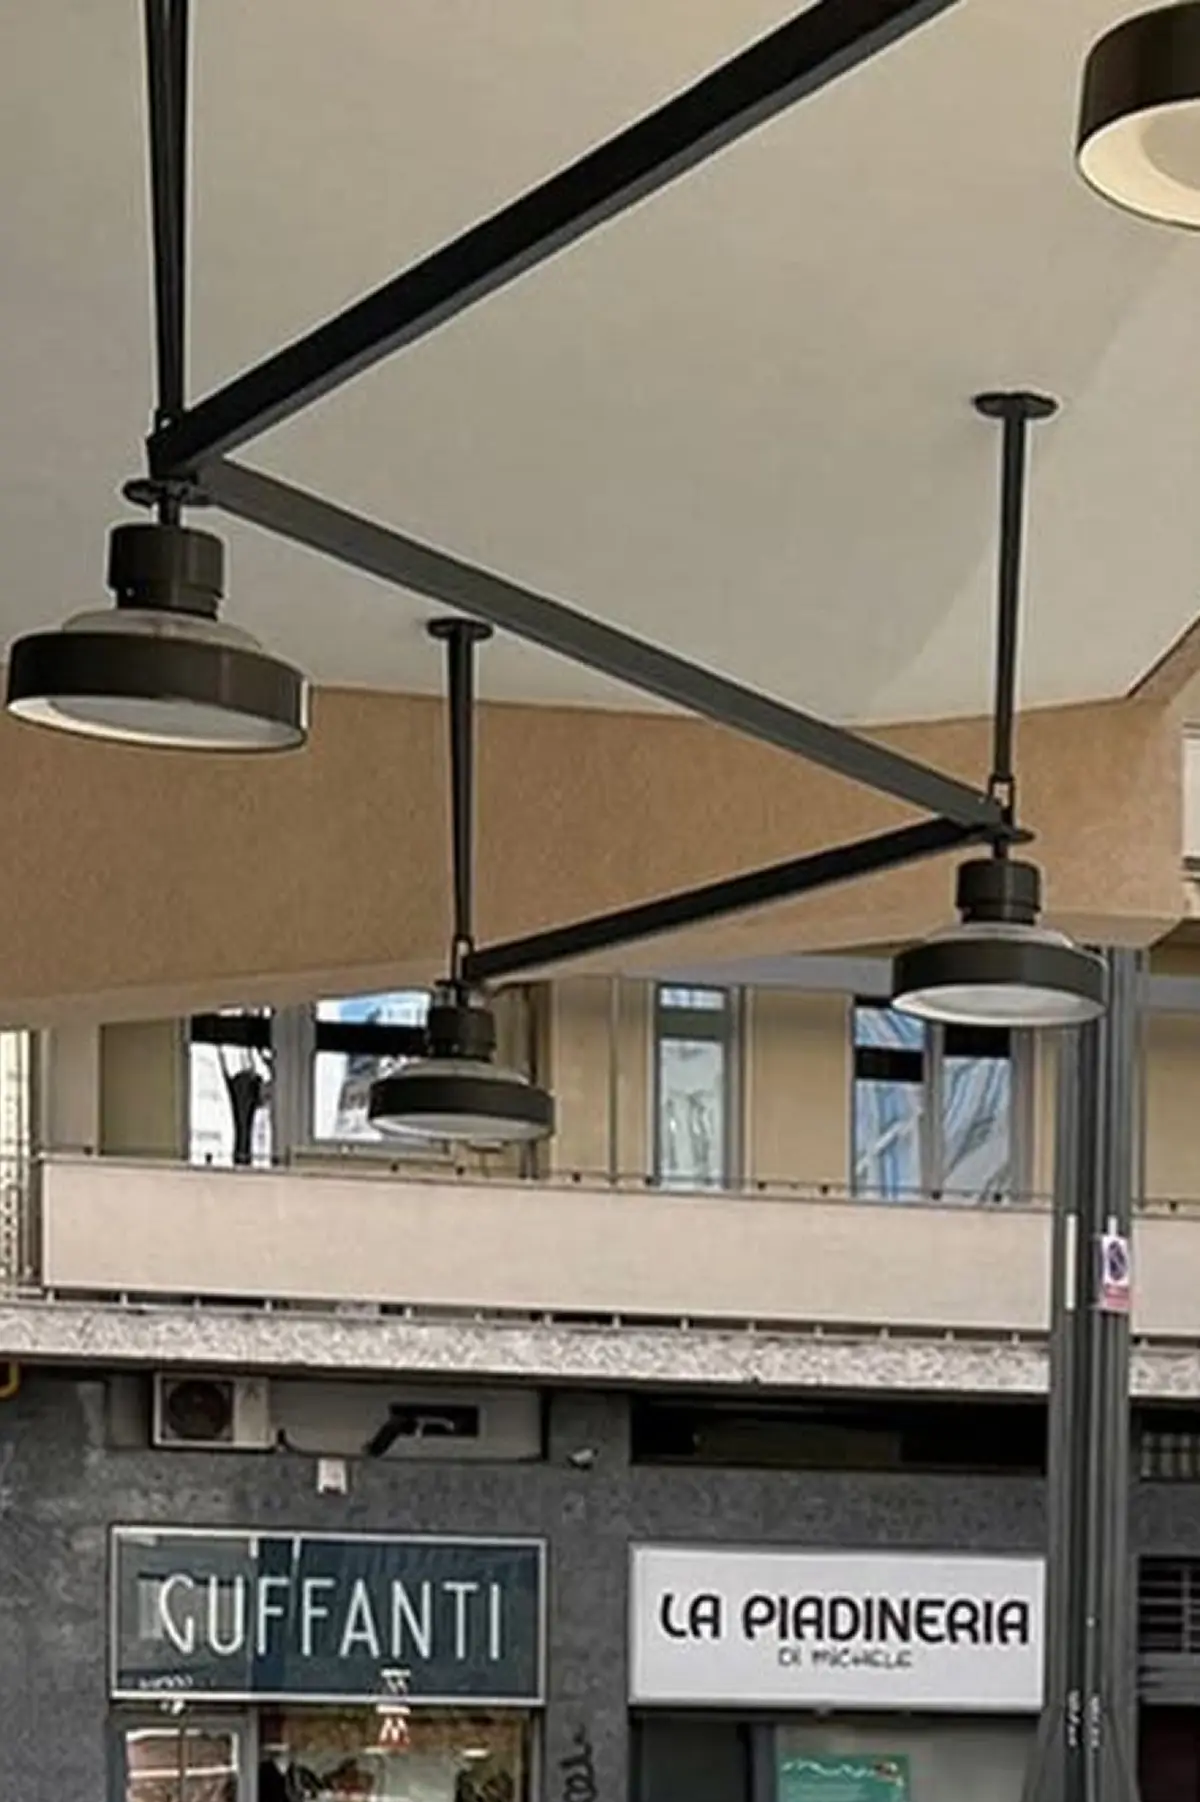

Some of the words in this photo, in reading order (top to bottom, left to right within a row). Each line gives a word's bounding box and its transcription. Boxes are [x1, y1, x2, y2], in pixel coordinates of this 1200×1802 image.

[158, 1573, 500, 1660] GUFFANTI
[660, 1593, 721, 1639] LA
[742, 1595, 1030, 1644] PIADINERIA
